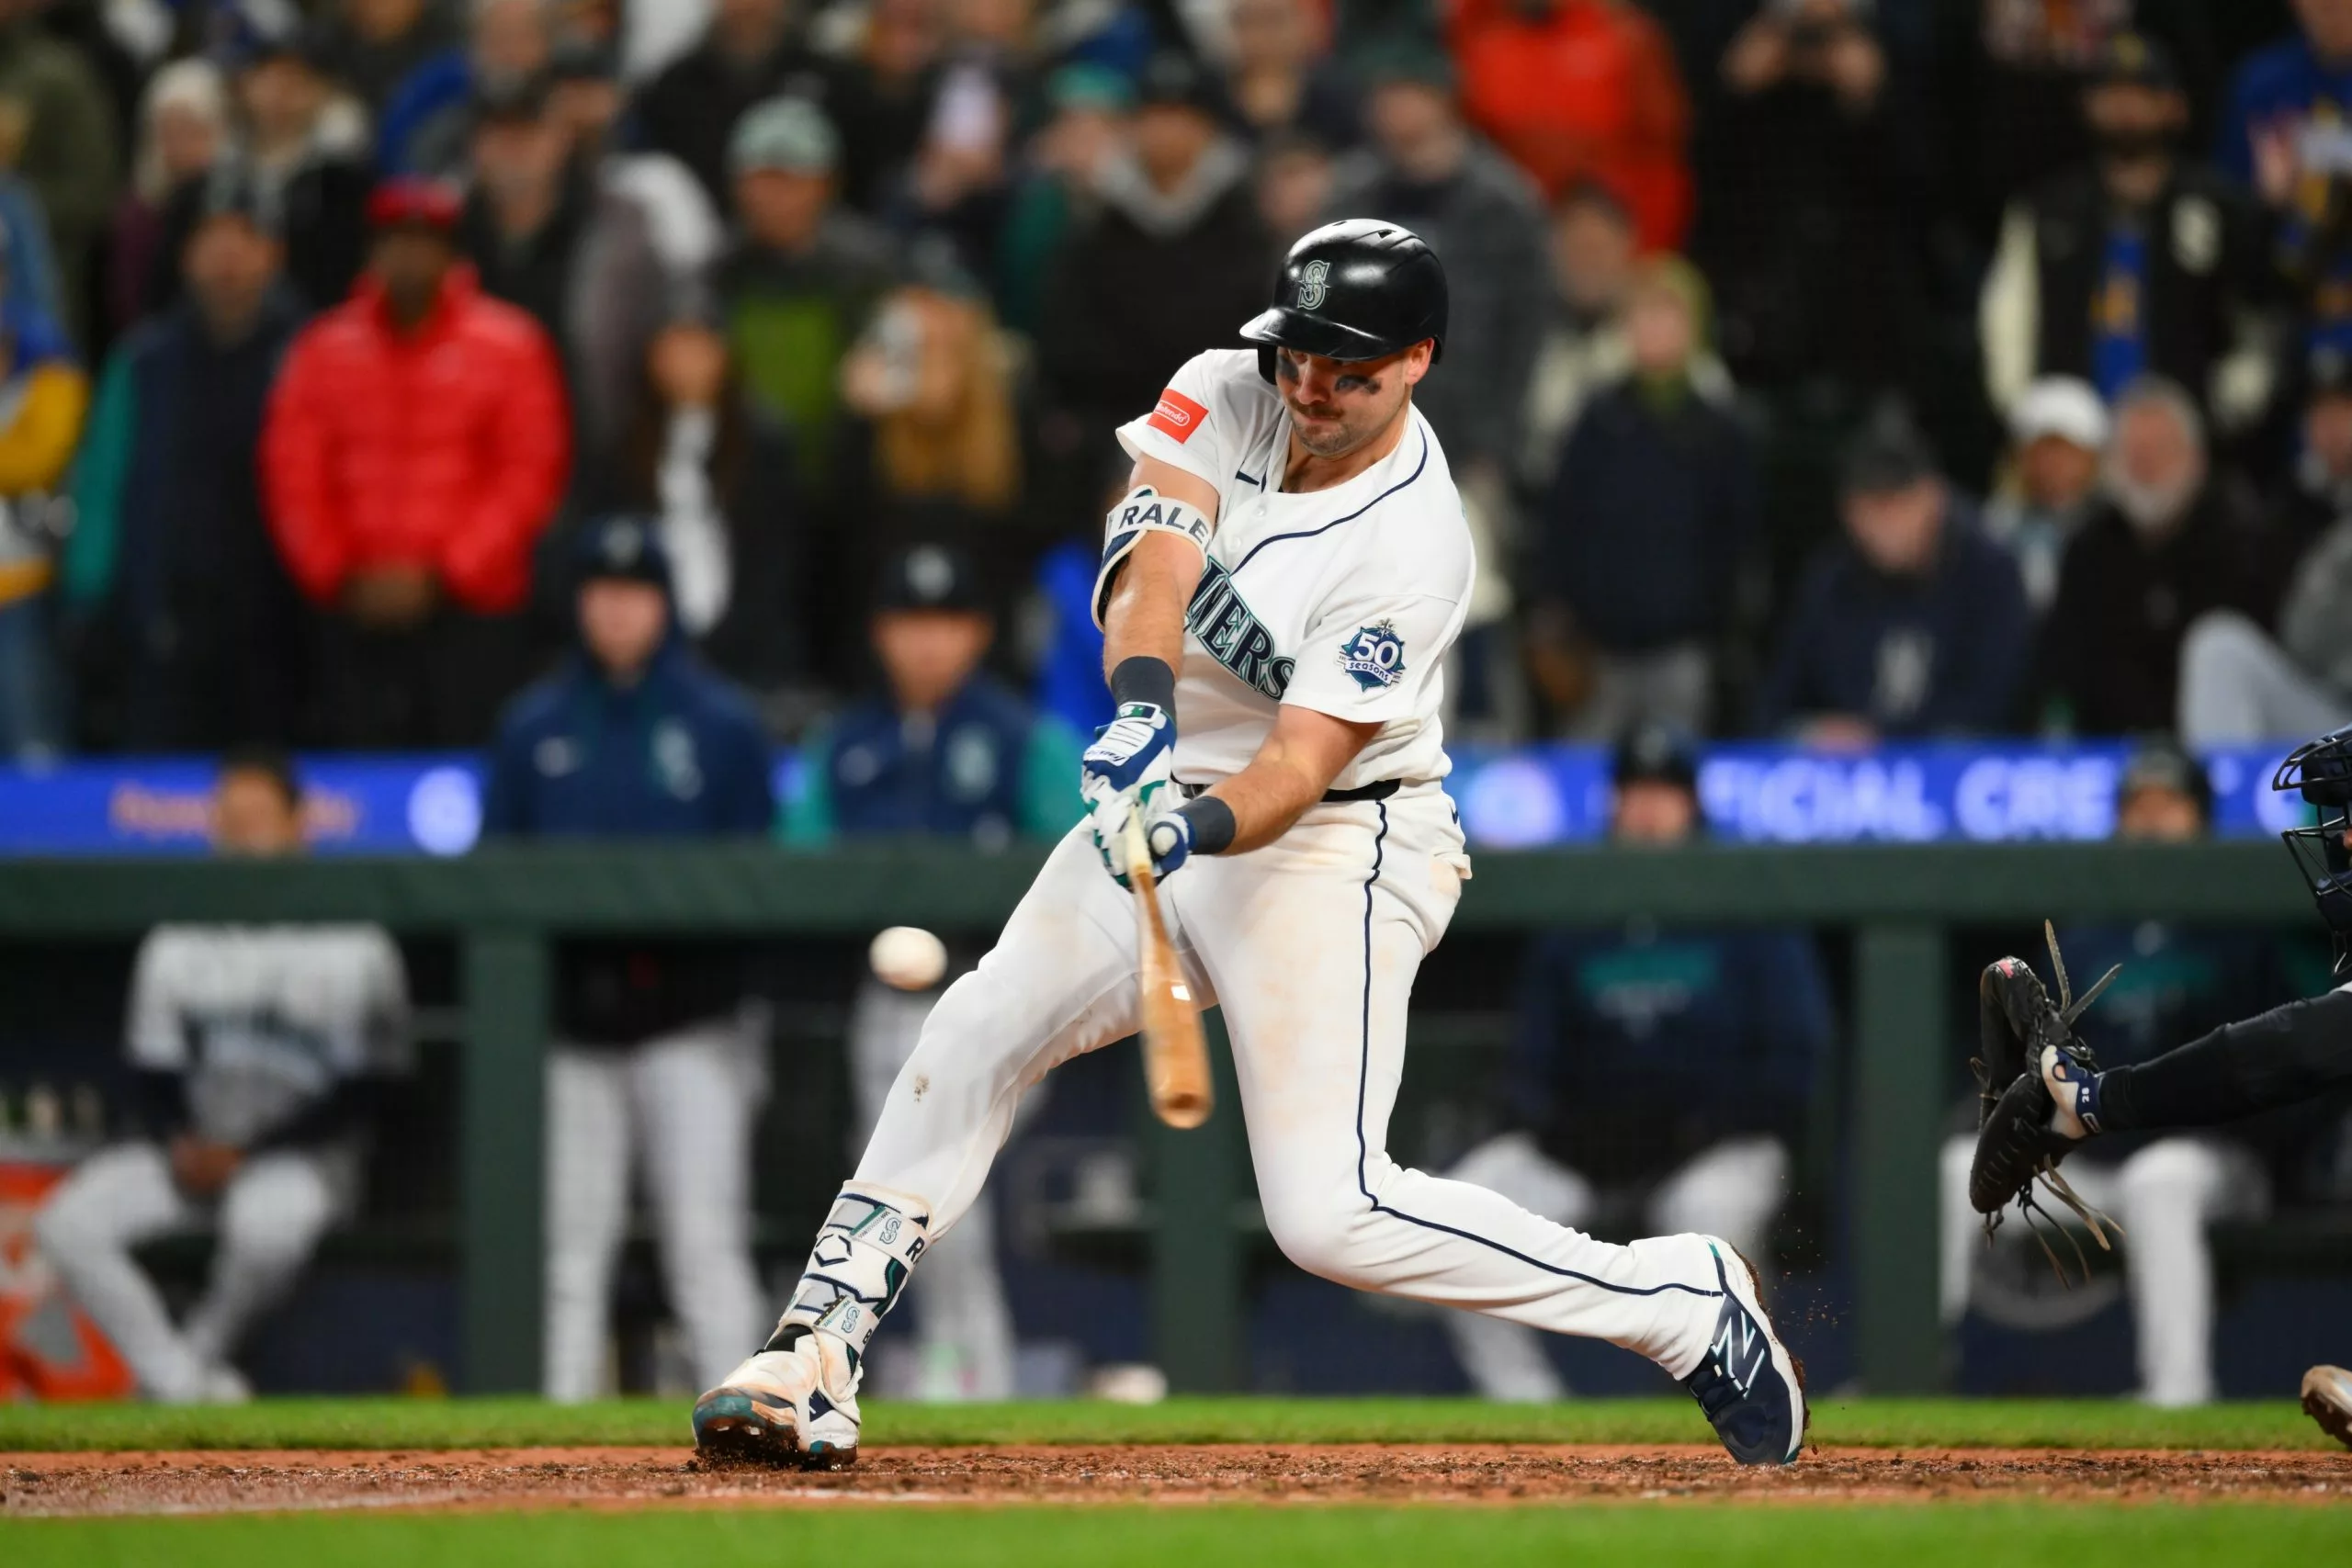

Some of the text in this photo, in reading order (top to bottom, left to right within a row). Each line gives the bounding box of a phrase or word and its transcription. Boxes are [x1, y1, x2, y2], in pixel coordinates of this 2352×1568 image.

[1297, 260, 1331, 310] S
[1118, 502, 1210, 551] RALE
[1349, 660, 1389, 682] seasons
[1353, 632, 1399, 670] 50
